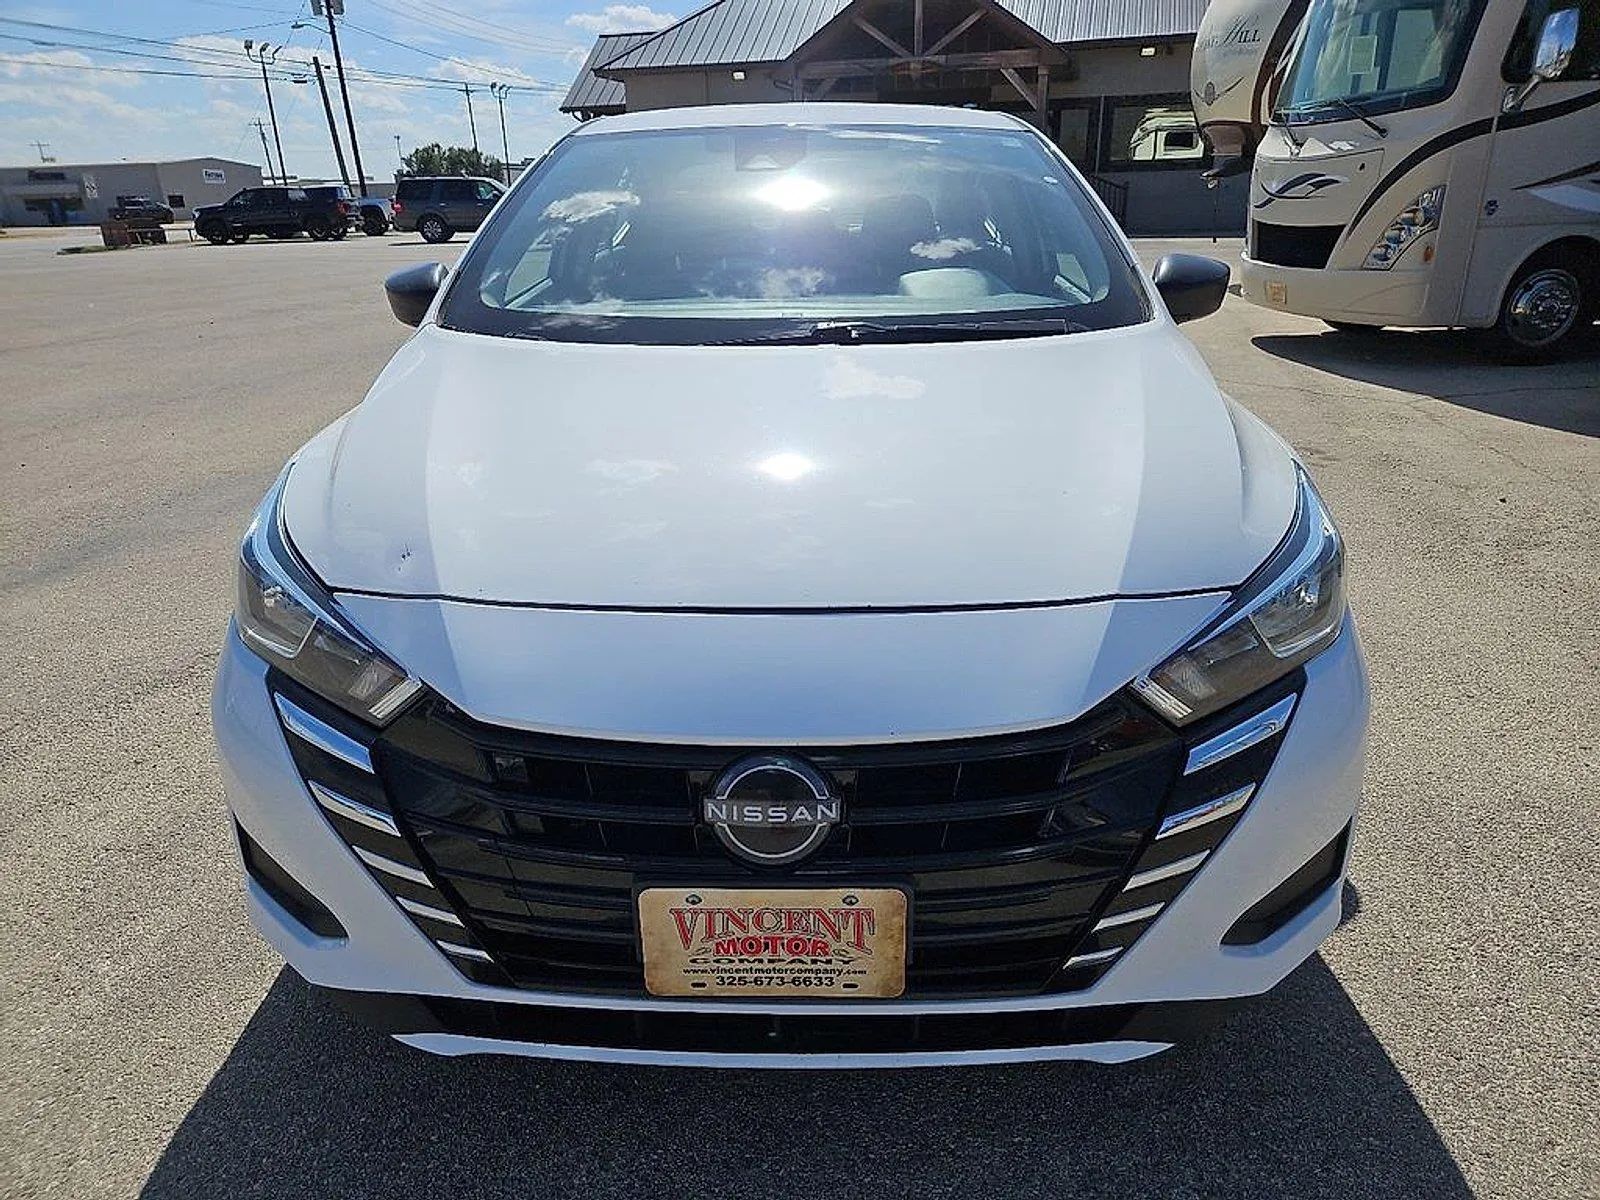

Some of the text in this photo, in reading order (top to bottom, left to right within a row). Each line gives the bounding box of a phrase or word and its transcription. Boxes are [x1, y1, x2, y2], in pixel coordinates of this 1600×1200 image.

[706, 802, 838, 822] NISSAN
[670, 908, 875, 954] VINCENT
[713, 935, 831, 956] MOTOR
[688, 957, 854, 965] COMPANY
[682, 966, 867, 977] www.vincentmotorcompany.com
[716, 976, 835, 987] 325-673-6633
